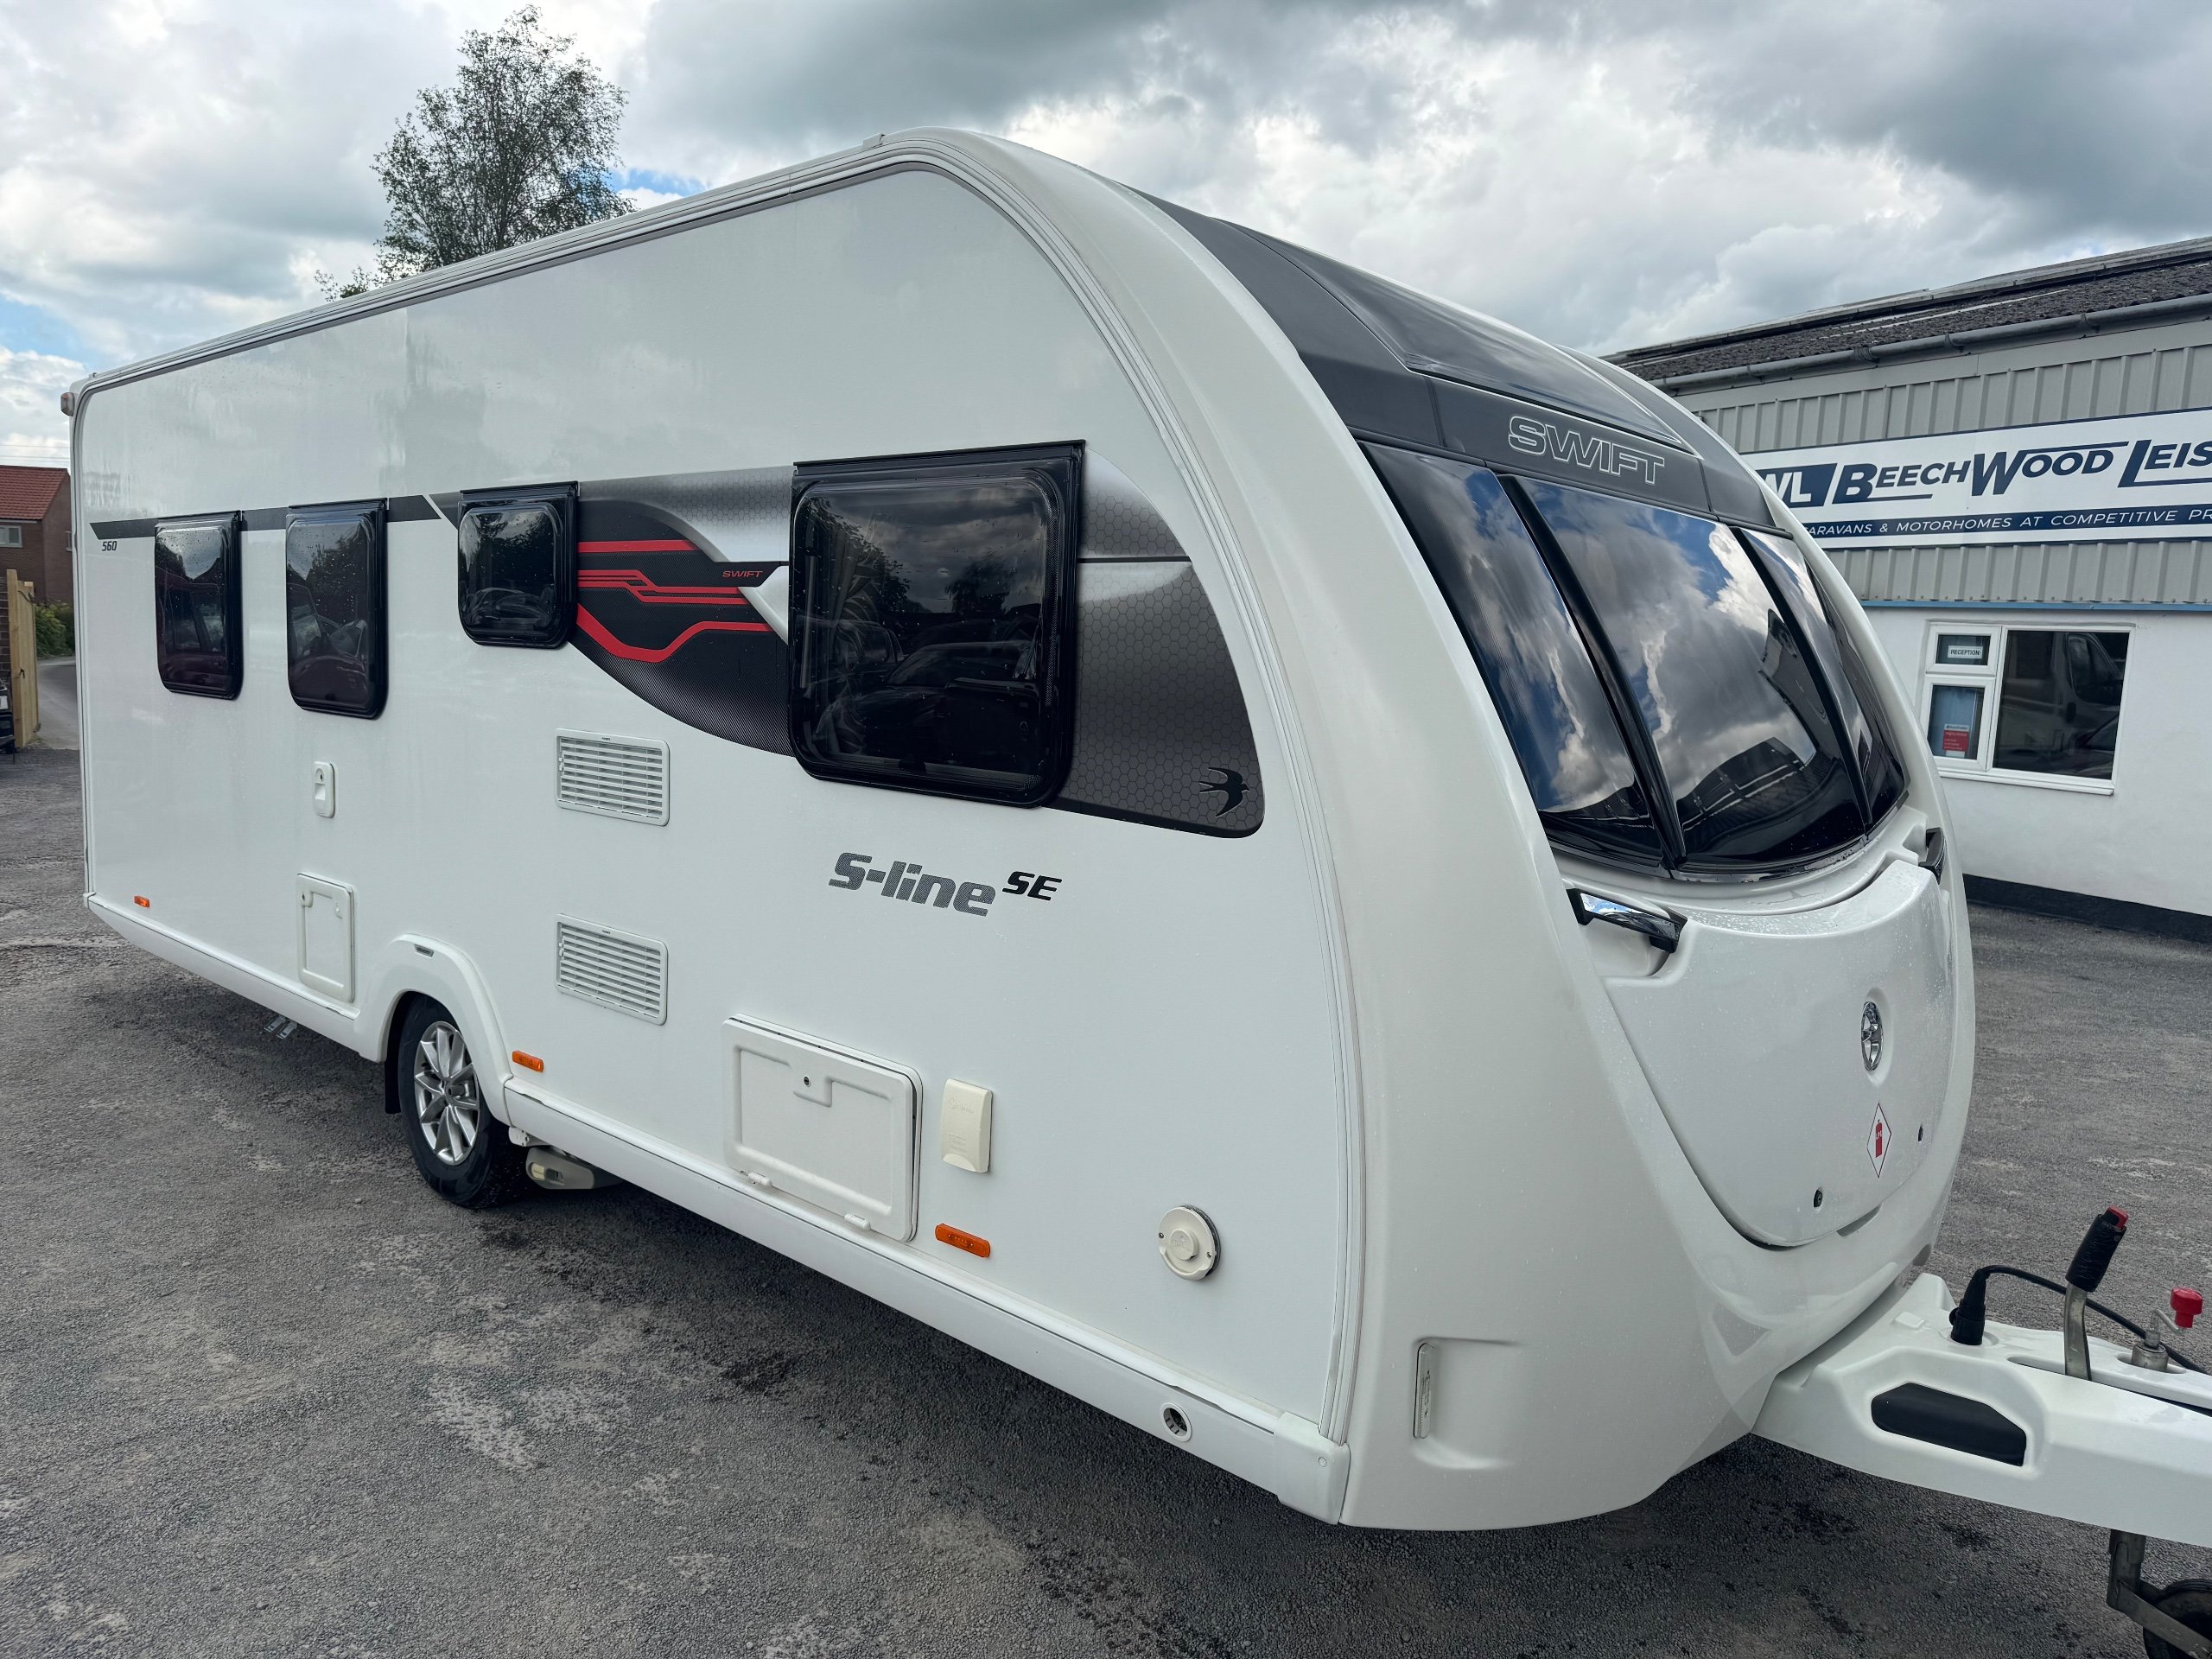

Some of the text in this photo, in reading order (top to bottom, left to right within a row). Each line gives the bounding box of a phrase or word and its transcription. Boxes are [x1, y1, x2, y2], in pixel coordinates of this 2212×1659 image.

[1509, 416, 1665, 485] SWIFT
[1805, 524, 1872, 536] ARAVANS
[1880, 523, 1888, 533] &
[1896, 517, 2012, 532] MOTORHOMES
[2019, 516, 2043, 526] AT
[2050, 510, 2178, 525] COMPETITIVE
[102, 541, 117, 551] 560
[828, 852, 1063, 917] S-line SE
